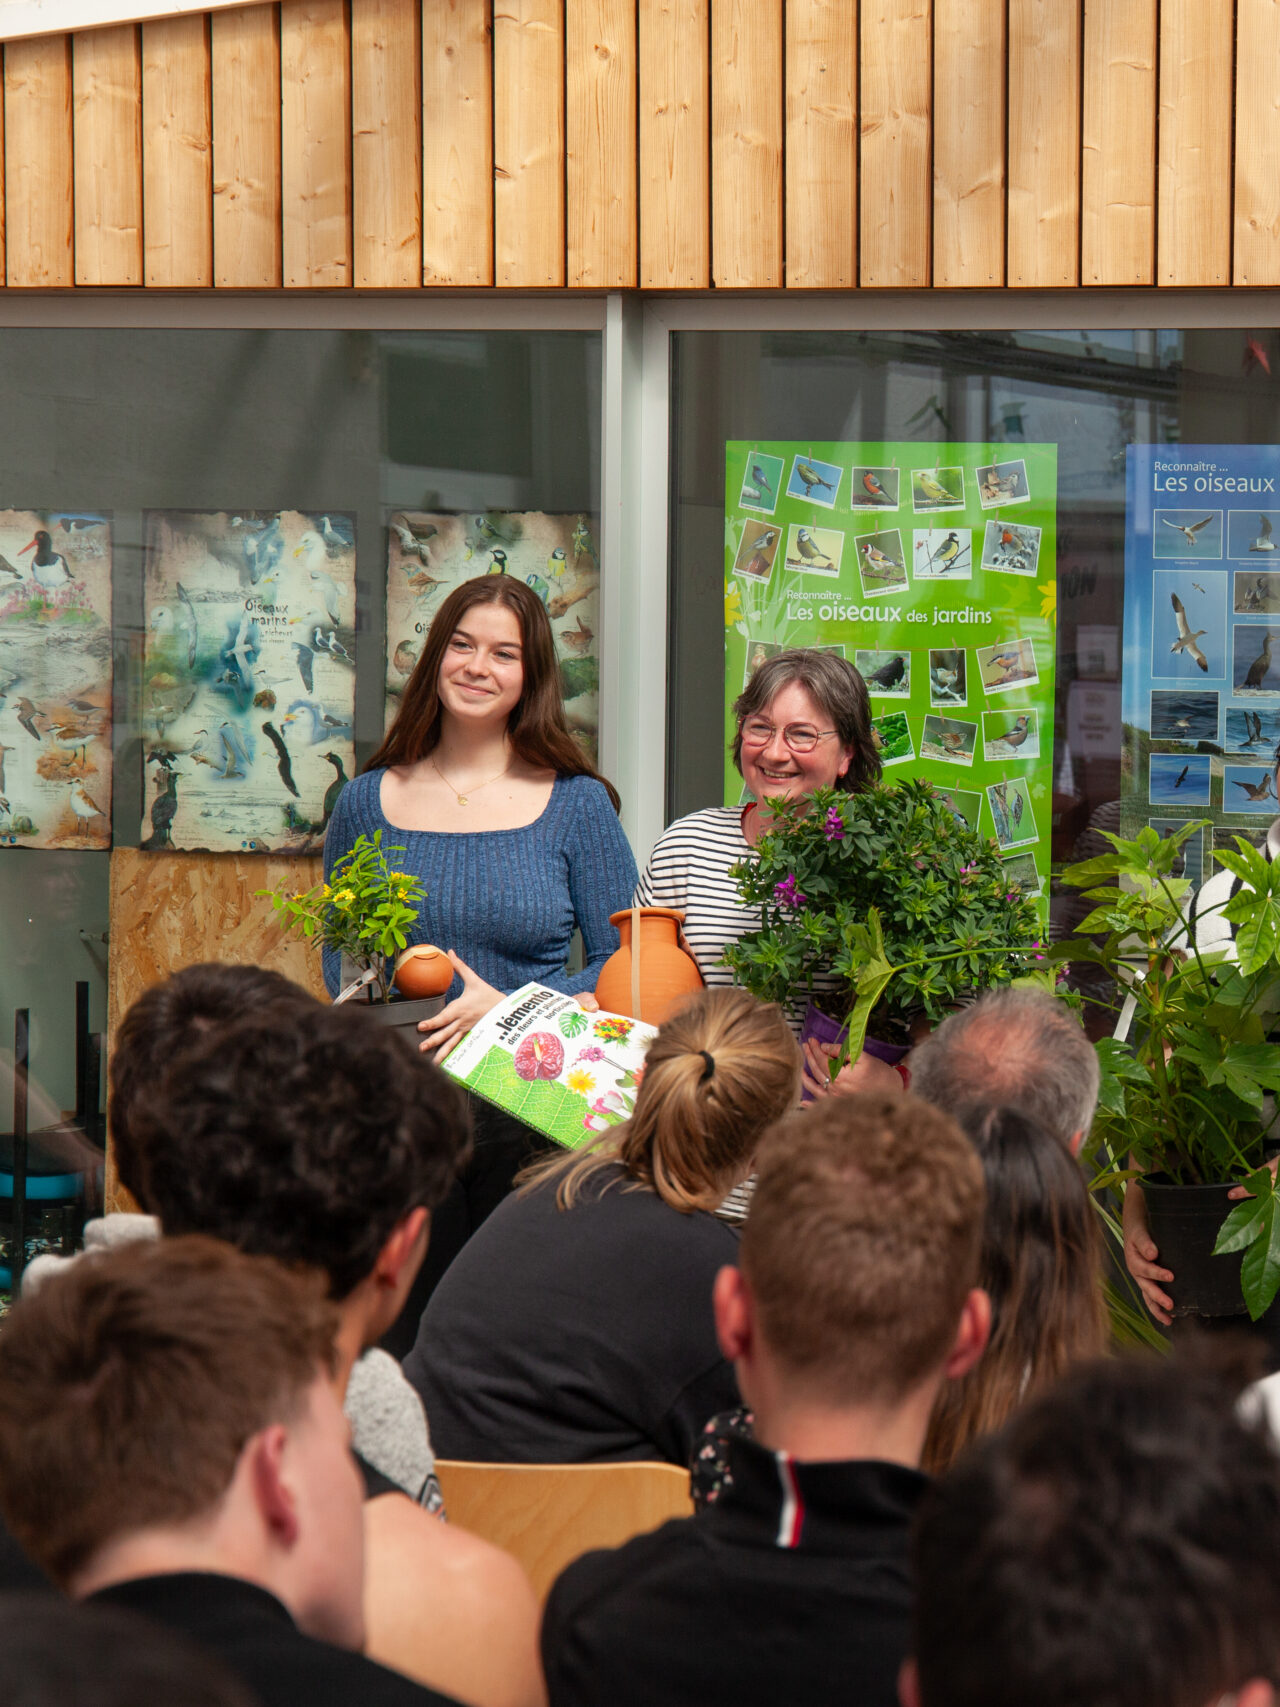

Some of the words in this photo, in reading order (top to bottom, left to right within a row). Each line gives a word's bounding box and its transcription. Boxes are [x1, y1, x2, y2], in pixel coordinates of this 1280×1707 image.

[1154, 461, 1217, 472] Reconnaître
[1153, 473, 1188, 493] Les
[1194, 472, 1276, 493] oiseaux
[786, 589, 842, 600] Reconnaître
[244, 598, 289, 615] Oiseaux
[786, 603, 813, 621] Les
[818, 601, 902, 622] oiseaux
[906, 609, 928, 623] des
[931, 606, 992, 626] jardins
[251, 617, 288, 626] marins
[507, 1032, 521, 1045] des
[517, 1015, 538, 1032] fleurs
[535, 1008, 544, 1016] et
